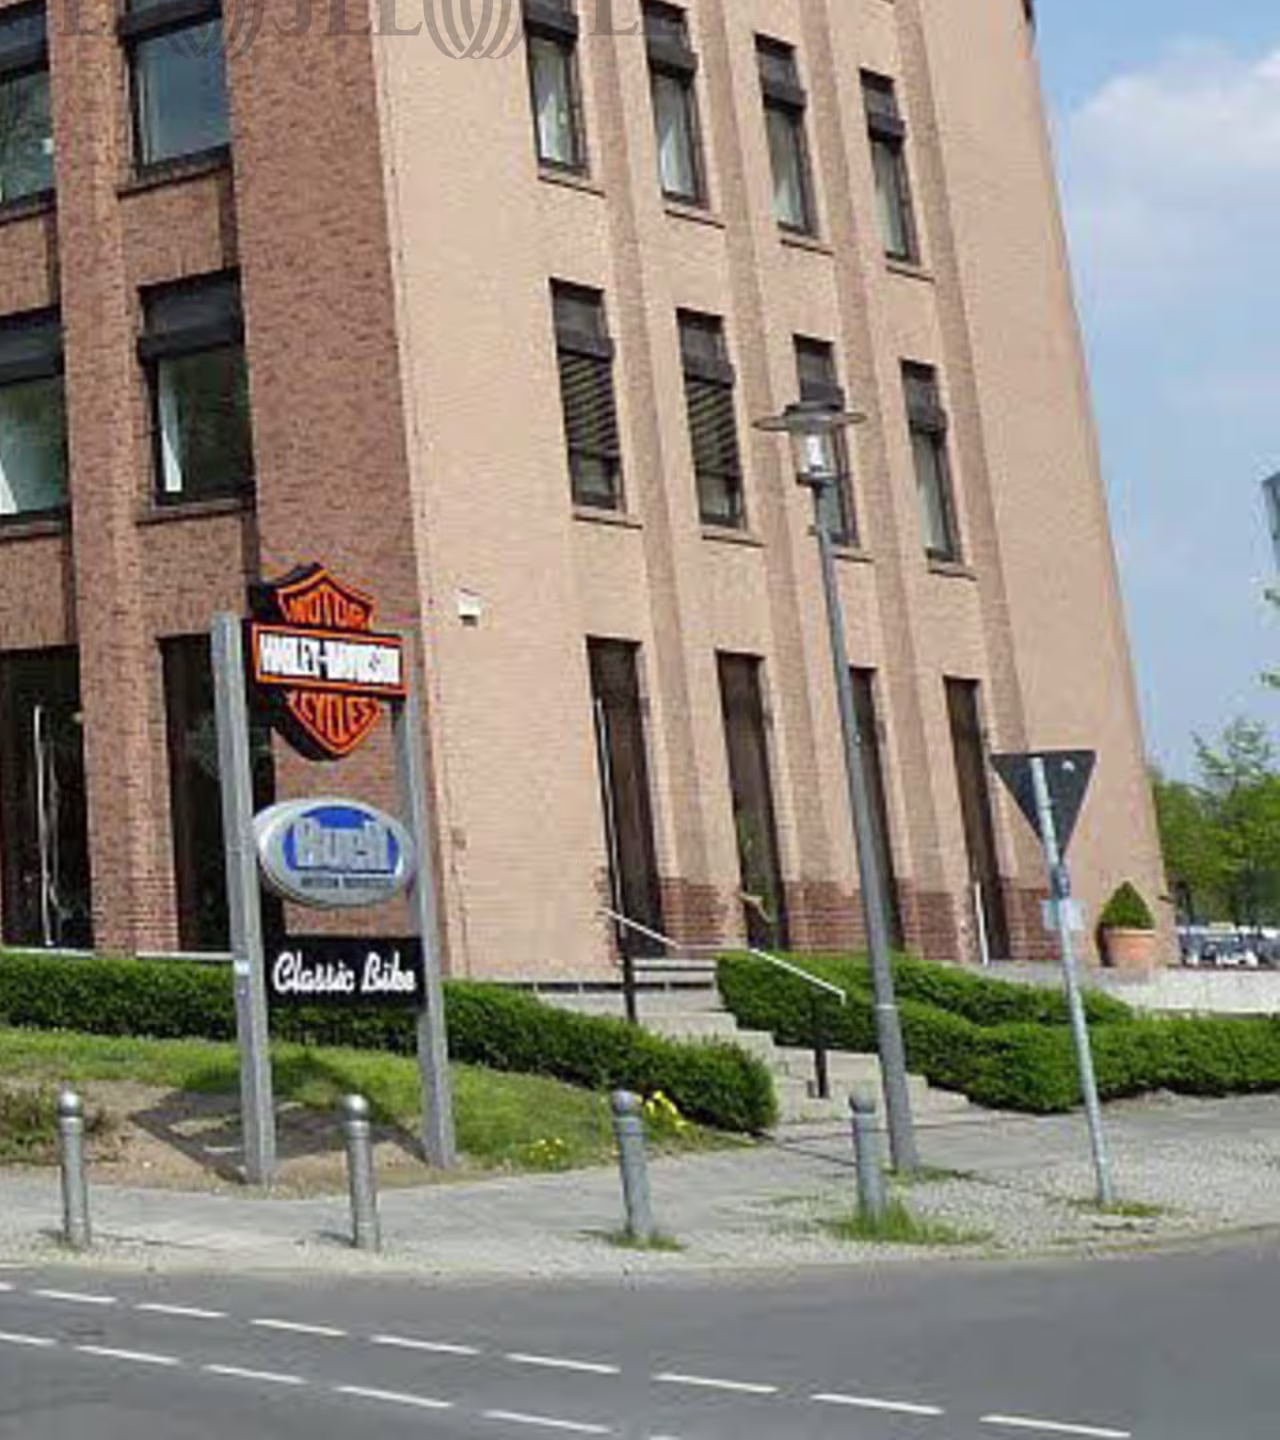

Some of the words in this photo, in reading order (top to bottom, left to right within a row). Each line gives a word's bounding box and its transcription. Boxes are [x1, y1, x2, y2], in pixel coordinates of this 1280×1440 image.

[288, 586, 366, 630] MOTOR
[259, 633, 400, 684] HARLEY-DAVIDSON
[298, 691, 372, 743] CYCLES
[273, 950, 355, 994] Classic
[360, 950, 416, 992] Bike
